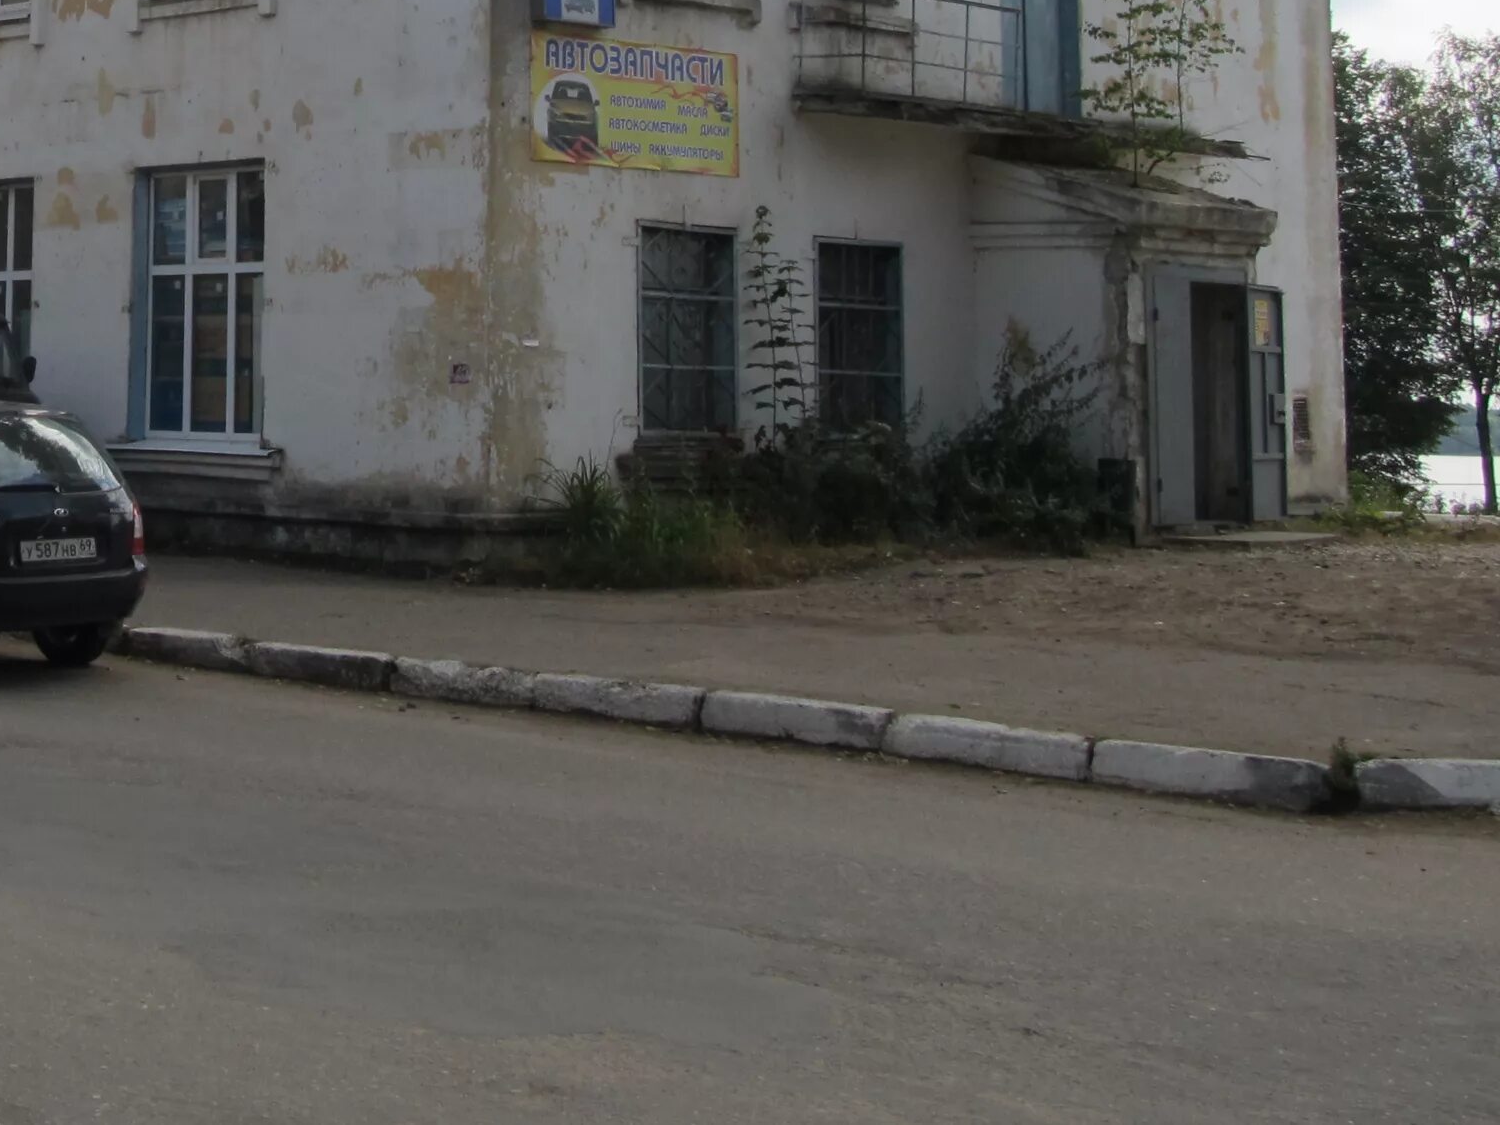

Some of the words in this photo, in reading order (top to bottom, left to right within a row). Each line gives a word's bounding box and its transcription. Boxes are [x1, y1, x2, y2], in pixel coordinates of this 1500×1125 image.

[545, 38, 725, 86] АВТОЗАПЧАСТИ
[609, 94, 667, 111] АВТОХИМИЯ
[677, 105, 709, 119] МАСЛА
[608, 119, 688, 135] АВТОКОСМЕТИКА
[699, 124, 731, 138] ДИСКИ
[610, 141, 641, 155] ШИНЫ
[648, 144, 724, 161] АККУМУЛЯТОРЫ
